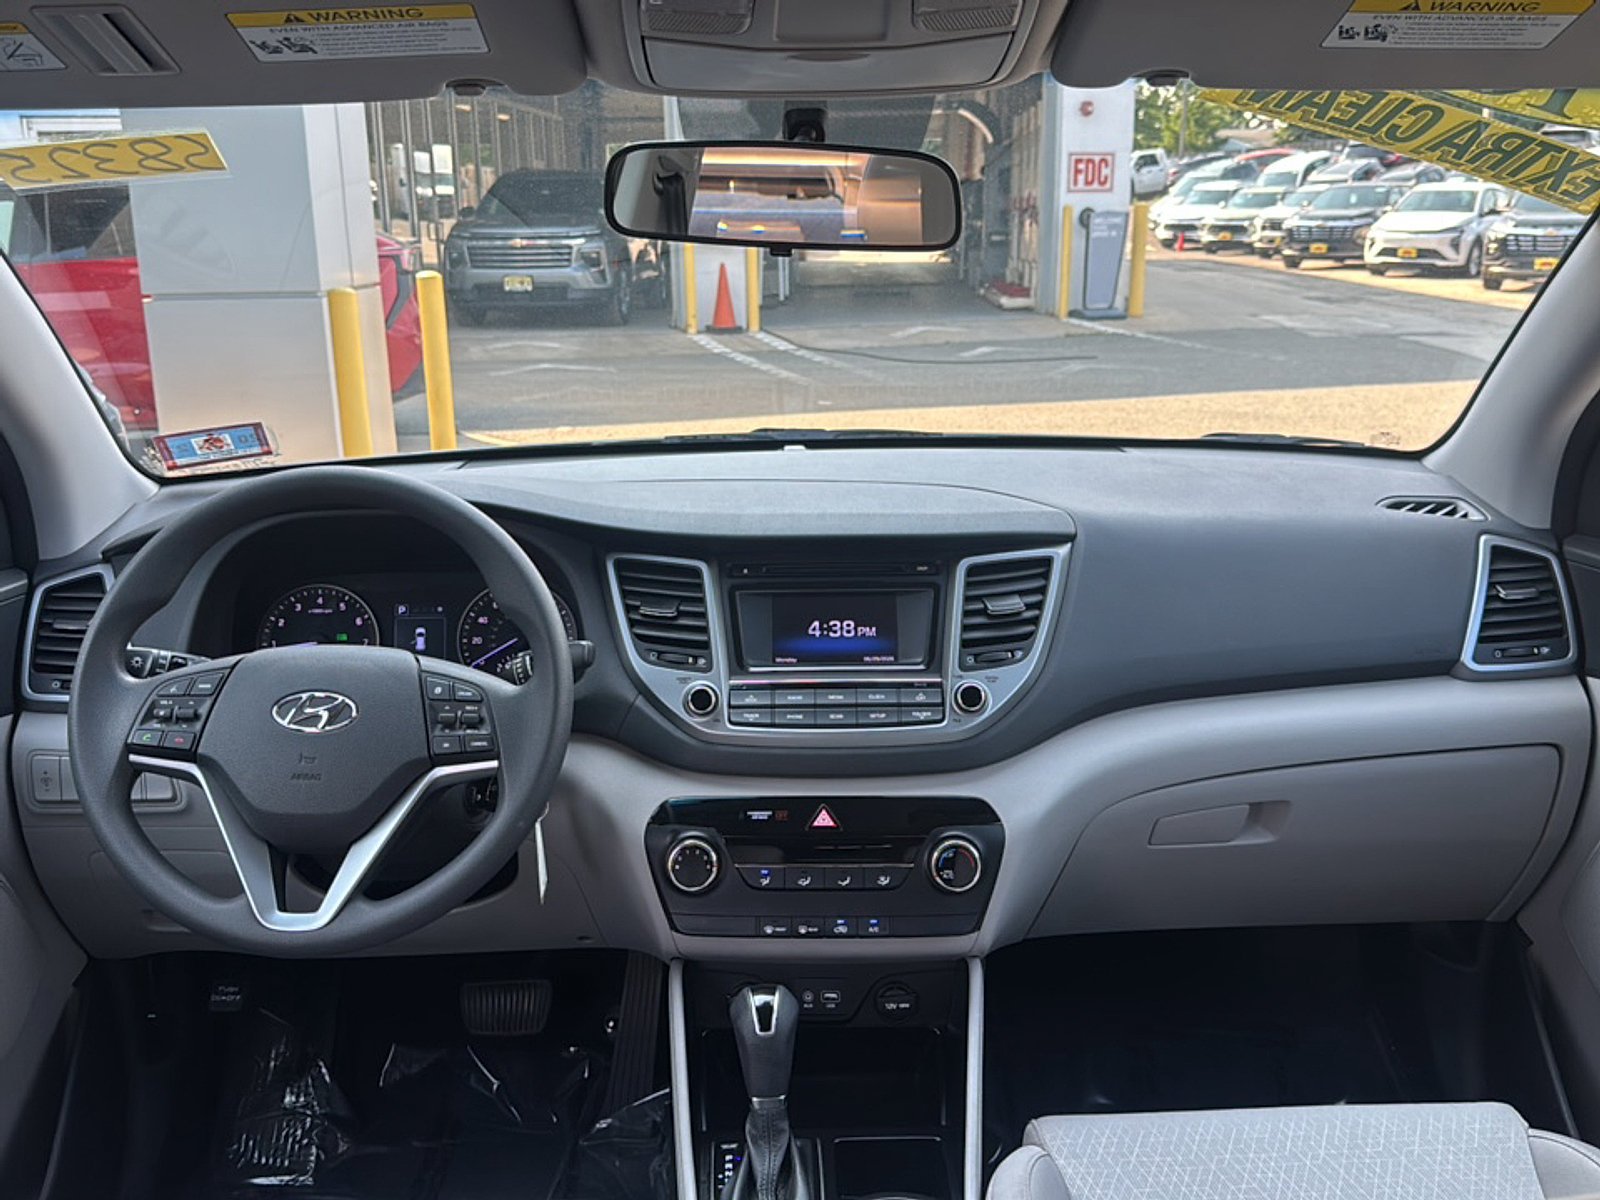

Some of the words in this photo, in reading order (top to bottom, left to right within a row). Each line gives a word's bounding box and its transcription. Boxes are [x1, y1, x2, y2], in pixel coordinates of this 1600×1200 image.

[1429, 1, 1540, 12] WARNING
[307, 8, 424, 22] WARNING
[1072, 157, 1110, 188] FDC
[808, 620, 855, 638] 4:38
[857, 626, 876, 637] PM
[471, 636, 483, 645] 20
